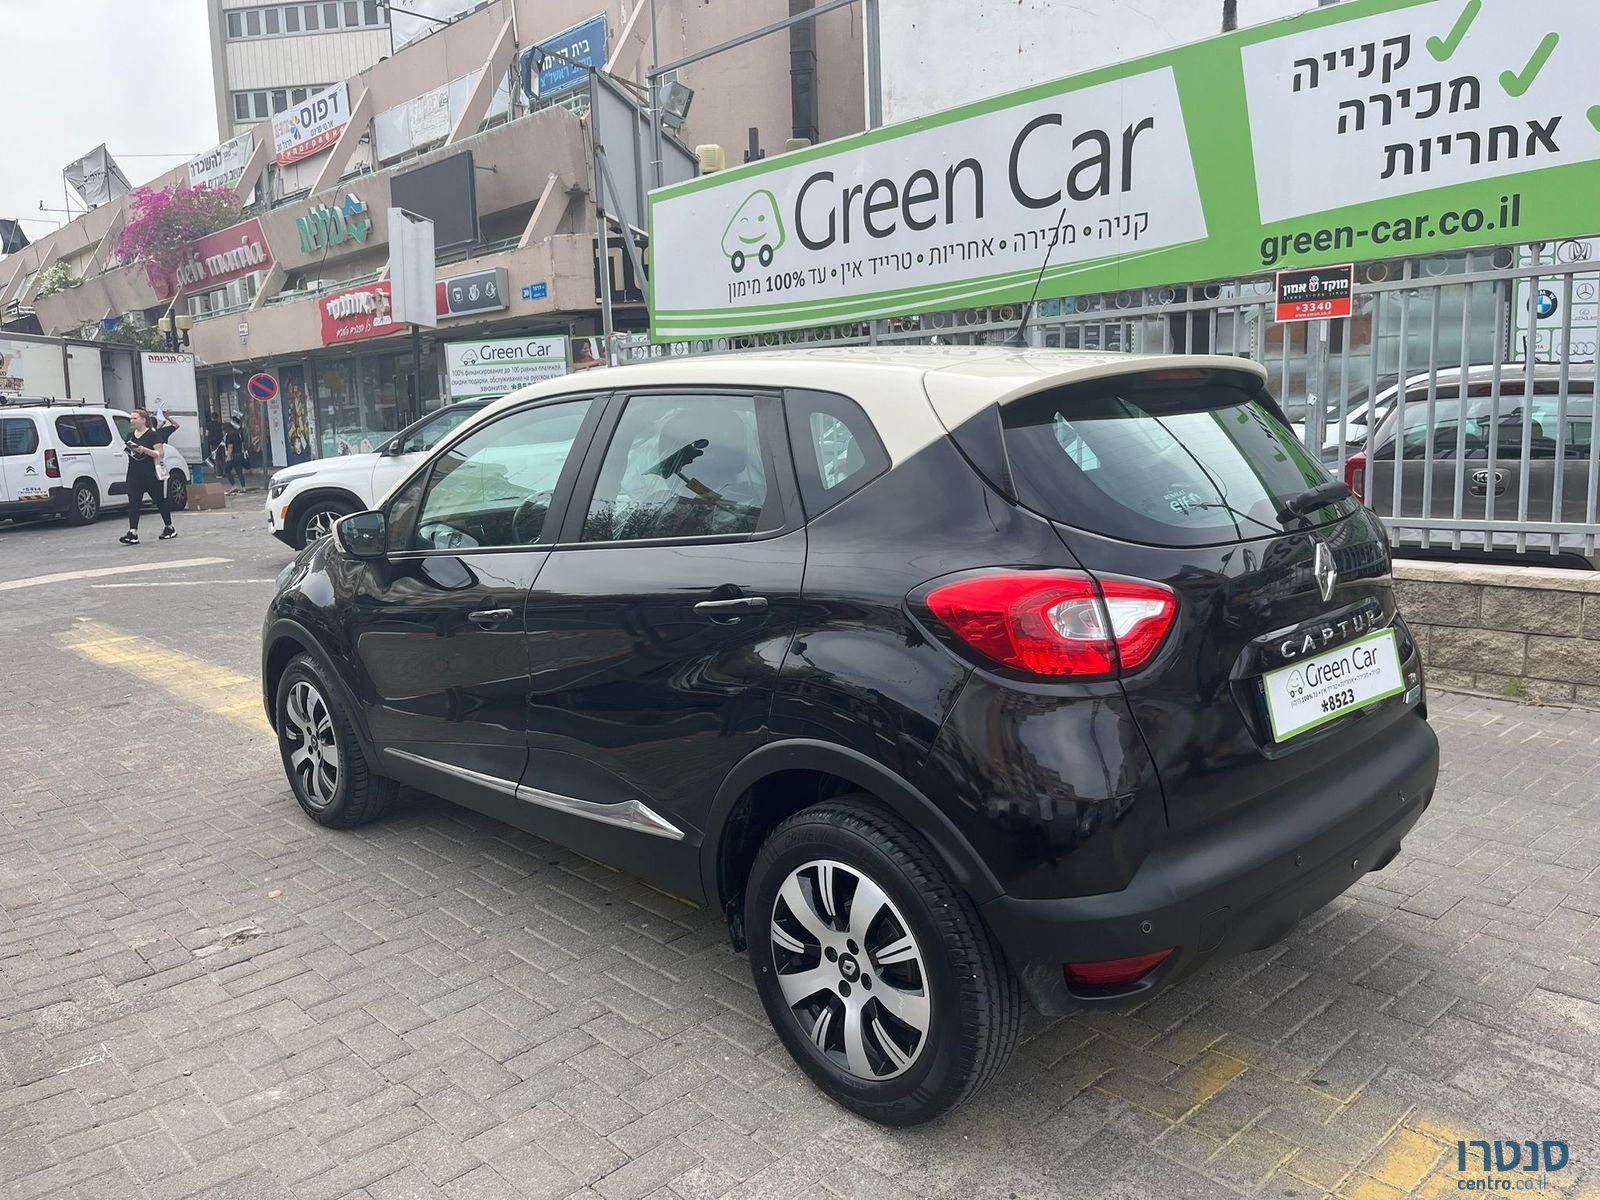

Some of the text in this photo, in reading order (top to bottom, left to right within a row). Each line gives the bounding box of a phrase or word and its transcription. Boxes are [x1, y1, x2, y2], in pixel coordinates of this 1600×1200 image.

[571, 39, 591, 58] בית
[1292, 34, 1412, 93] קנייה
[300, 92, 339, 129] דפוס
[1337, 75, 1481, 134] מכירה
[1380, 116, 1563, 180] אחריות
[794, 113, 1154, 251] Green Car
[1260, 194, 1521, 266] green-car.co.il
[205, 235, 267, 277] mania
[727, 212, 1149, 303] קניה מכירה אחריות טרייד אין עד 100% מימון
[1282, 283, 1307, 297] אמון
[1321, 279, 1349, 292] מוקד
[480, 341, 552, 361] Green Car
[1280, 610, 1375, 658] CAPTUR
[1305, 646, 1378, 688] Green Car
